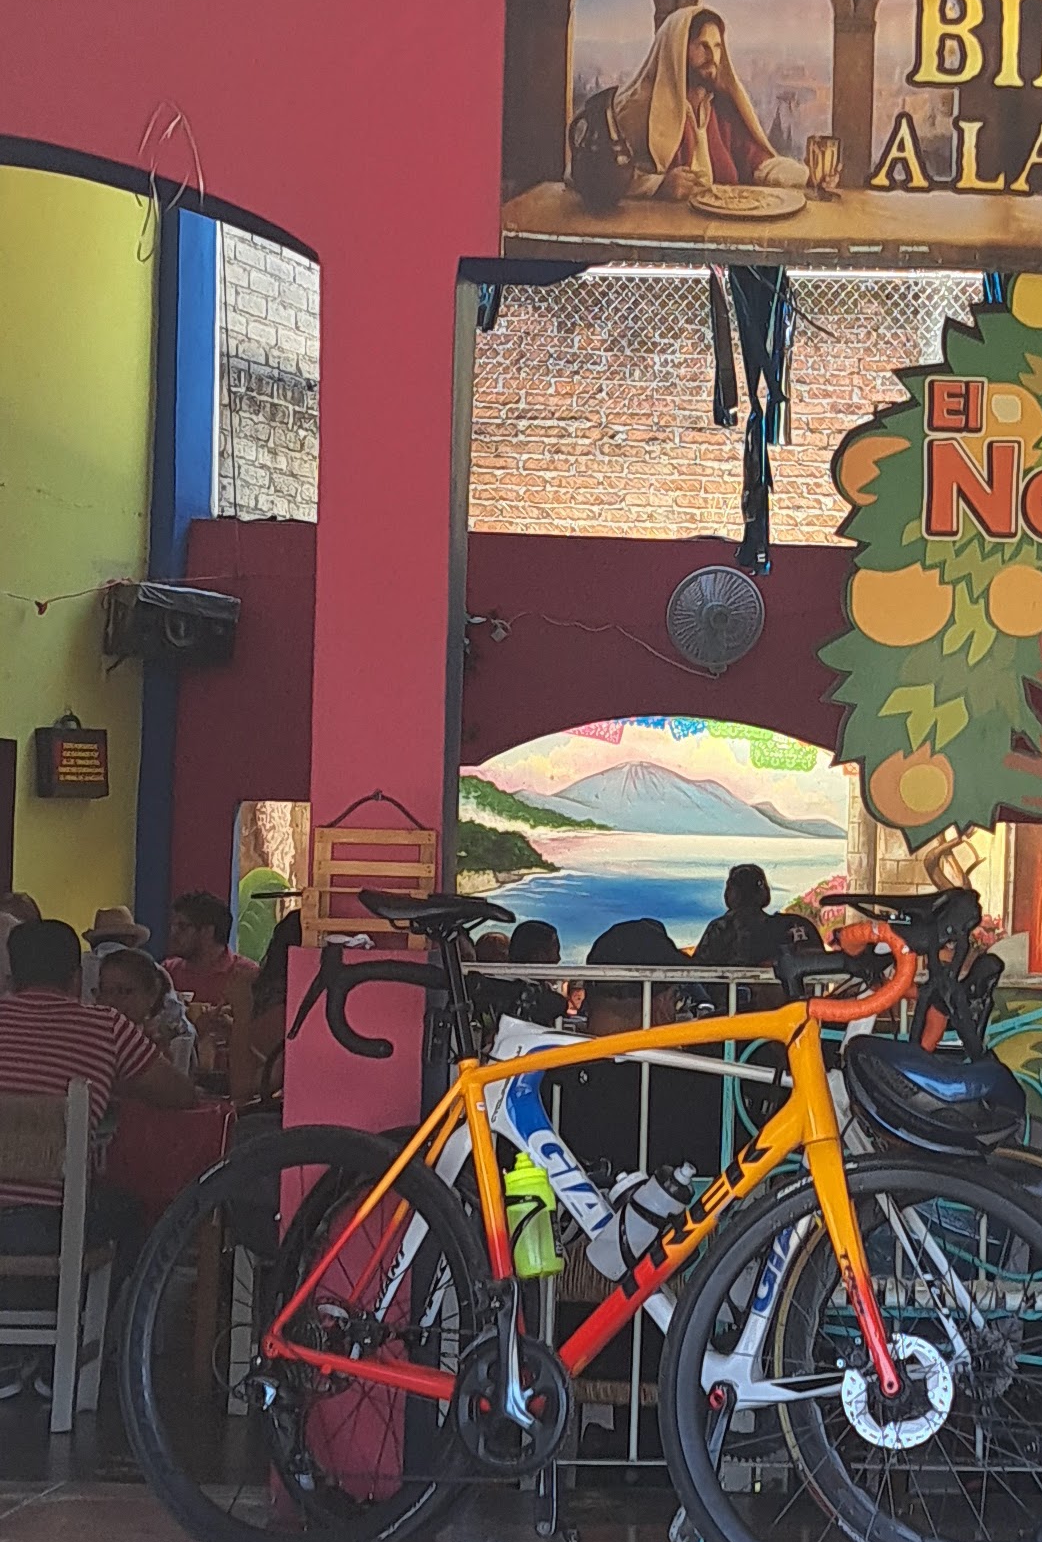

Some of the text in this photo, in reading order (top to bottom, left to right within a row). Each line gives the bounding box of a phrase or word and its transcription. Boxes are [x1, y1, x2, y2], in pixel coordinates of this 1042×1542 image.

[870, 117, 930, 189] A
[926, 379, 985, 433] El
[619, 1139, 774, 1300] TREK
